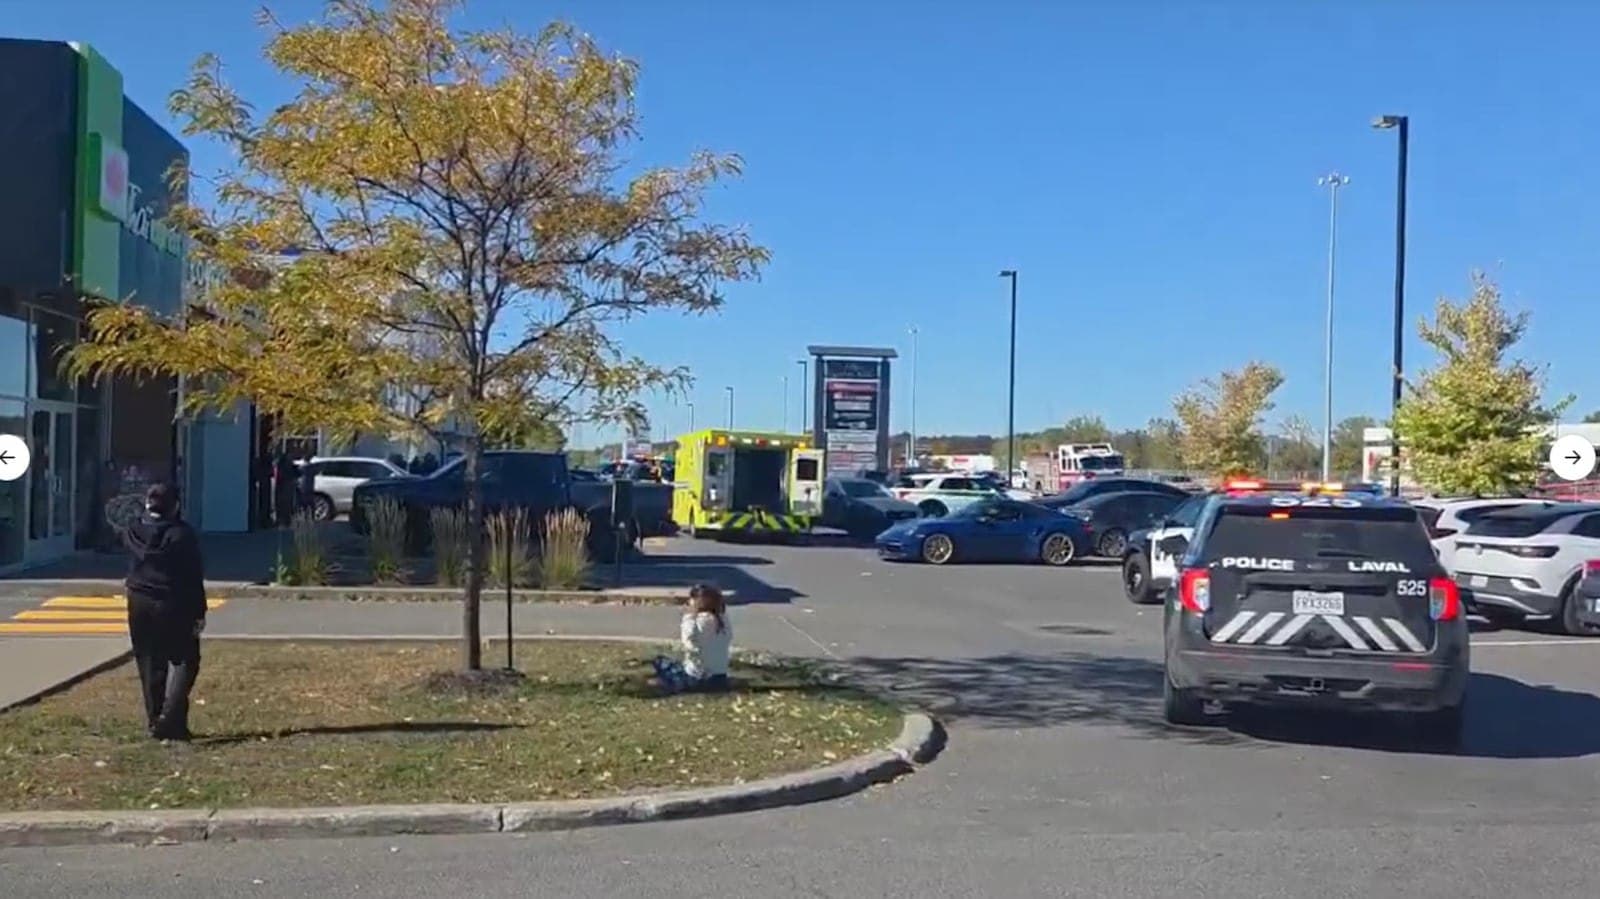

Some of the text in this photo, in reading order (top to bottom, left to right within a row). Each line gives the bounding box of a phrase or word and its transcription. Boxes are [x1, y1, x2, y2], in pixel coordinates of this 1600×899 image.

[1222, 557, 1411, 573] POLICE LAVAL
[1397, 580, 1427, 596] 525
